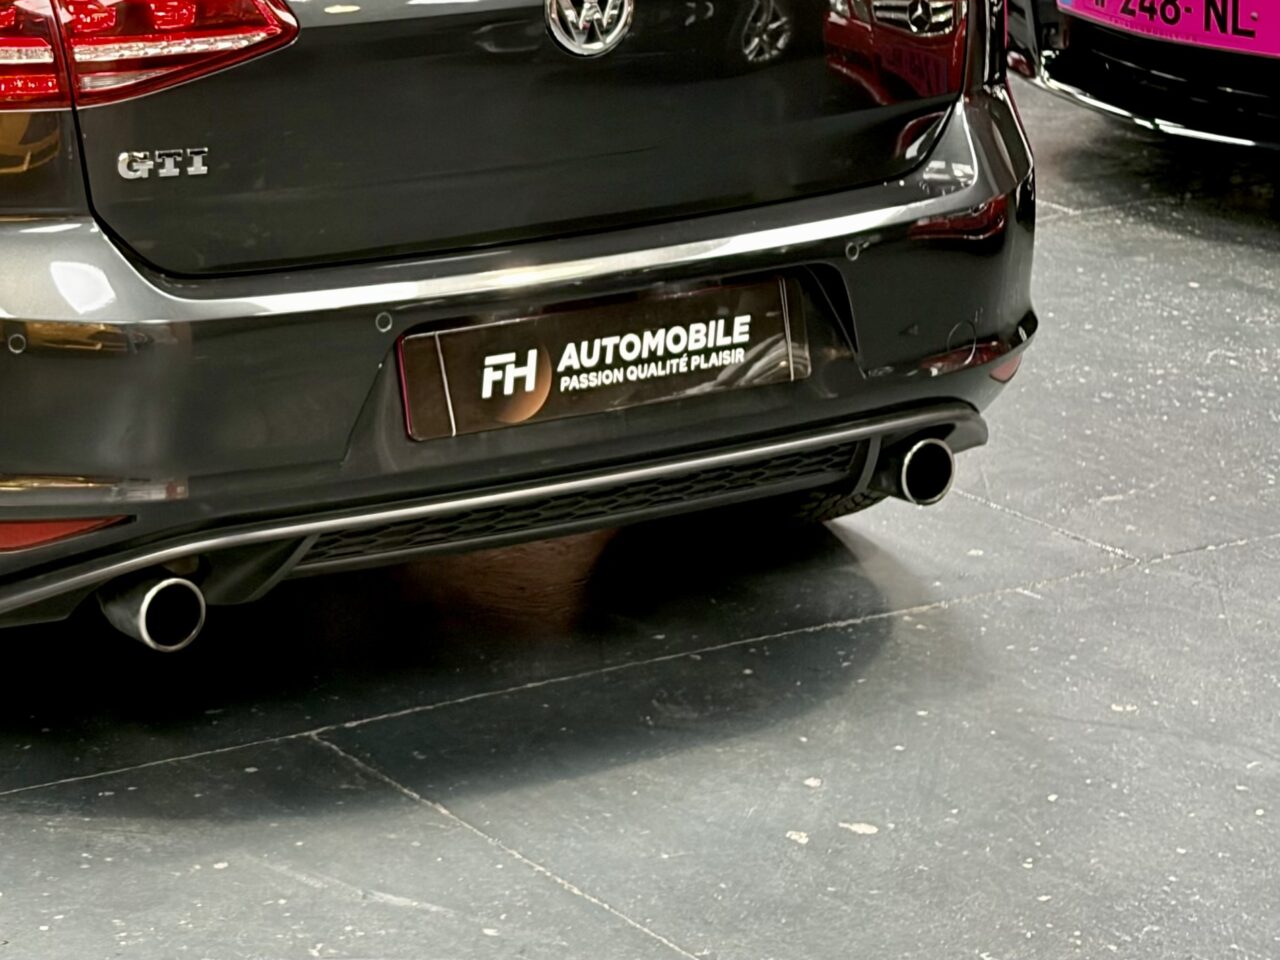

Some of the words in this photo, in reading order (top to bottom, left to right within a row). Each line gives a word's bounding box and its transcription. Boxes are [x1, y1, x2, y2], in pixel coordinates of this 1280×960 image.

[117, 147, 208, 179] GTI
[481, 348, 538, 399] FH
[557, 314, 751, 372] AUTOMOBILE
[560, 366, 624, 392] PASSION
[626, 354, 688, 381] QUALITÉ
[690, 348, 745, 372] PLAISIR
